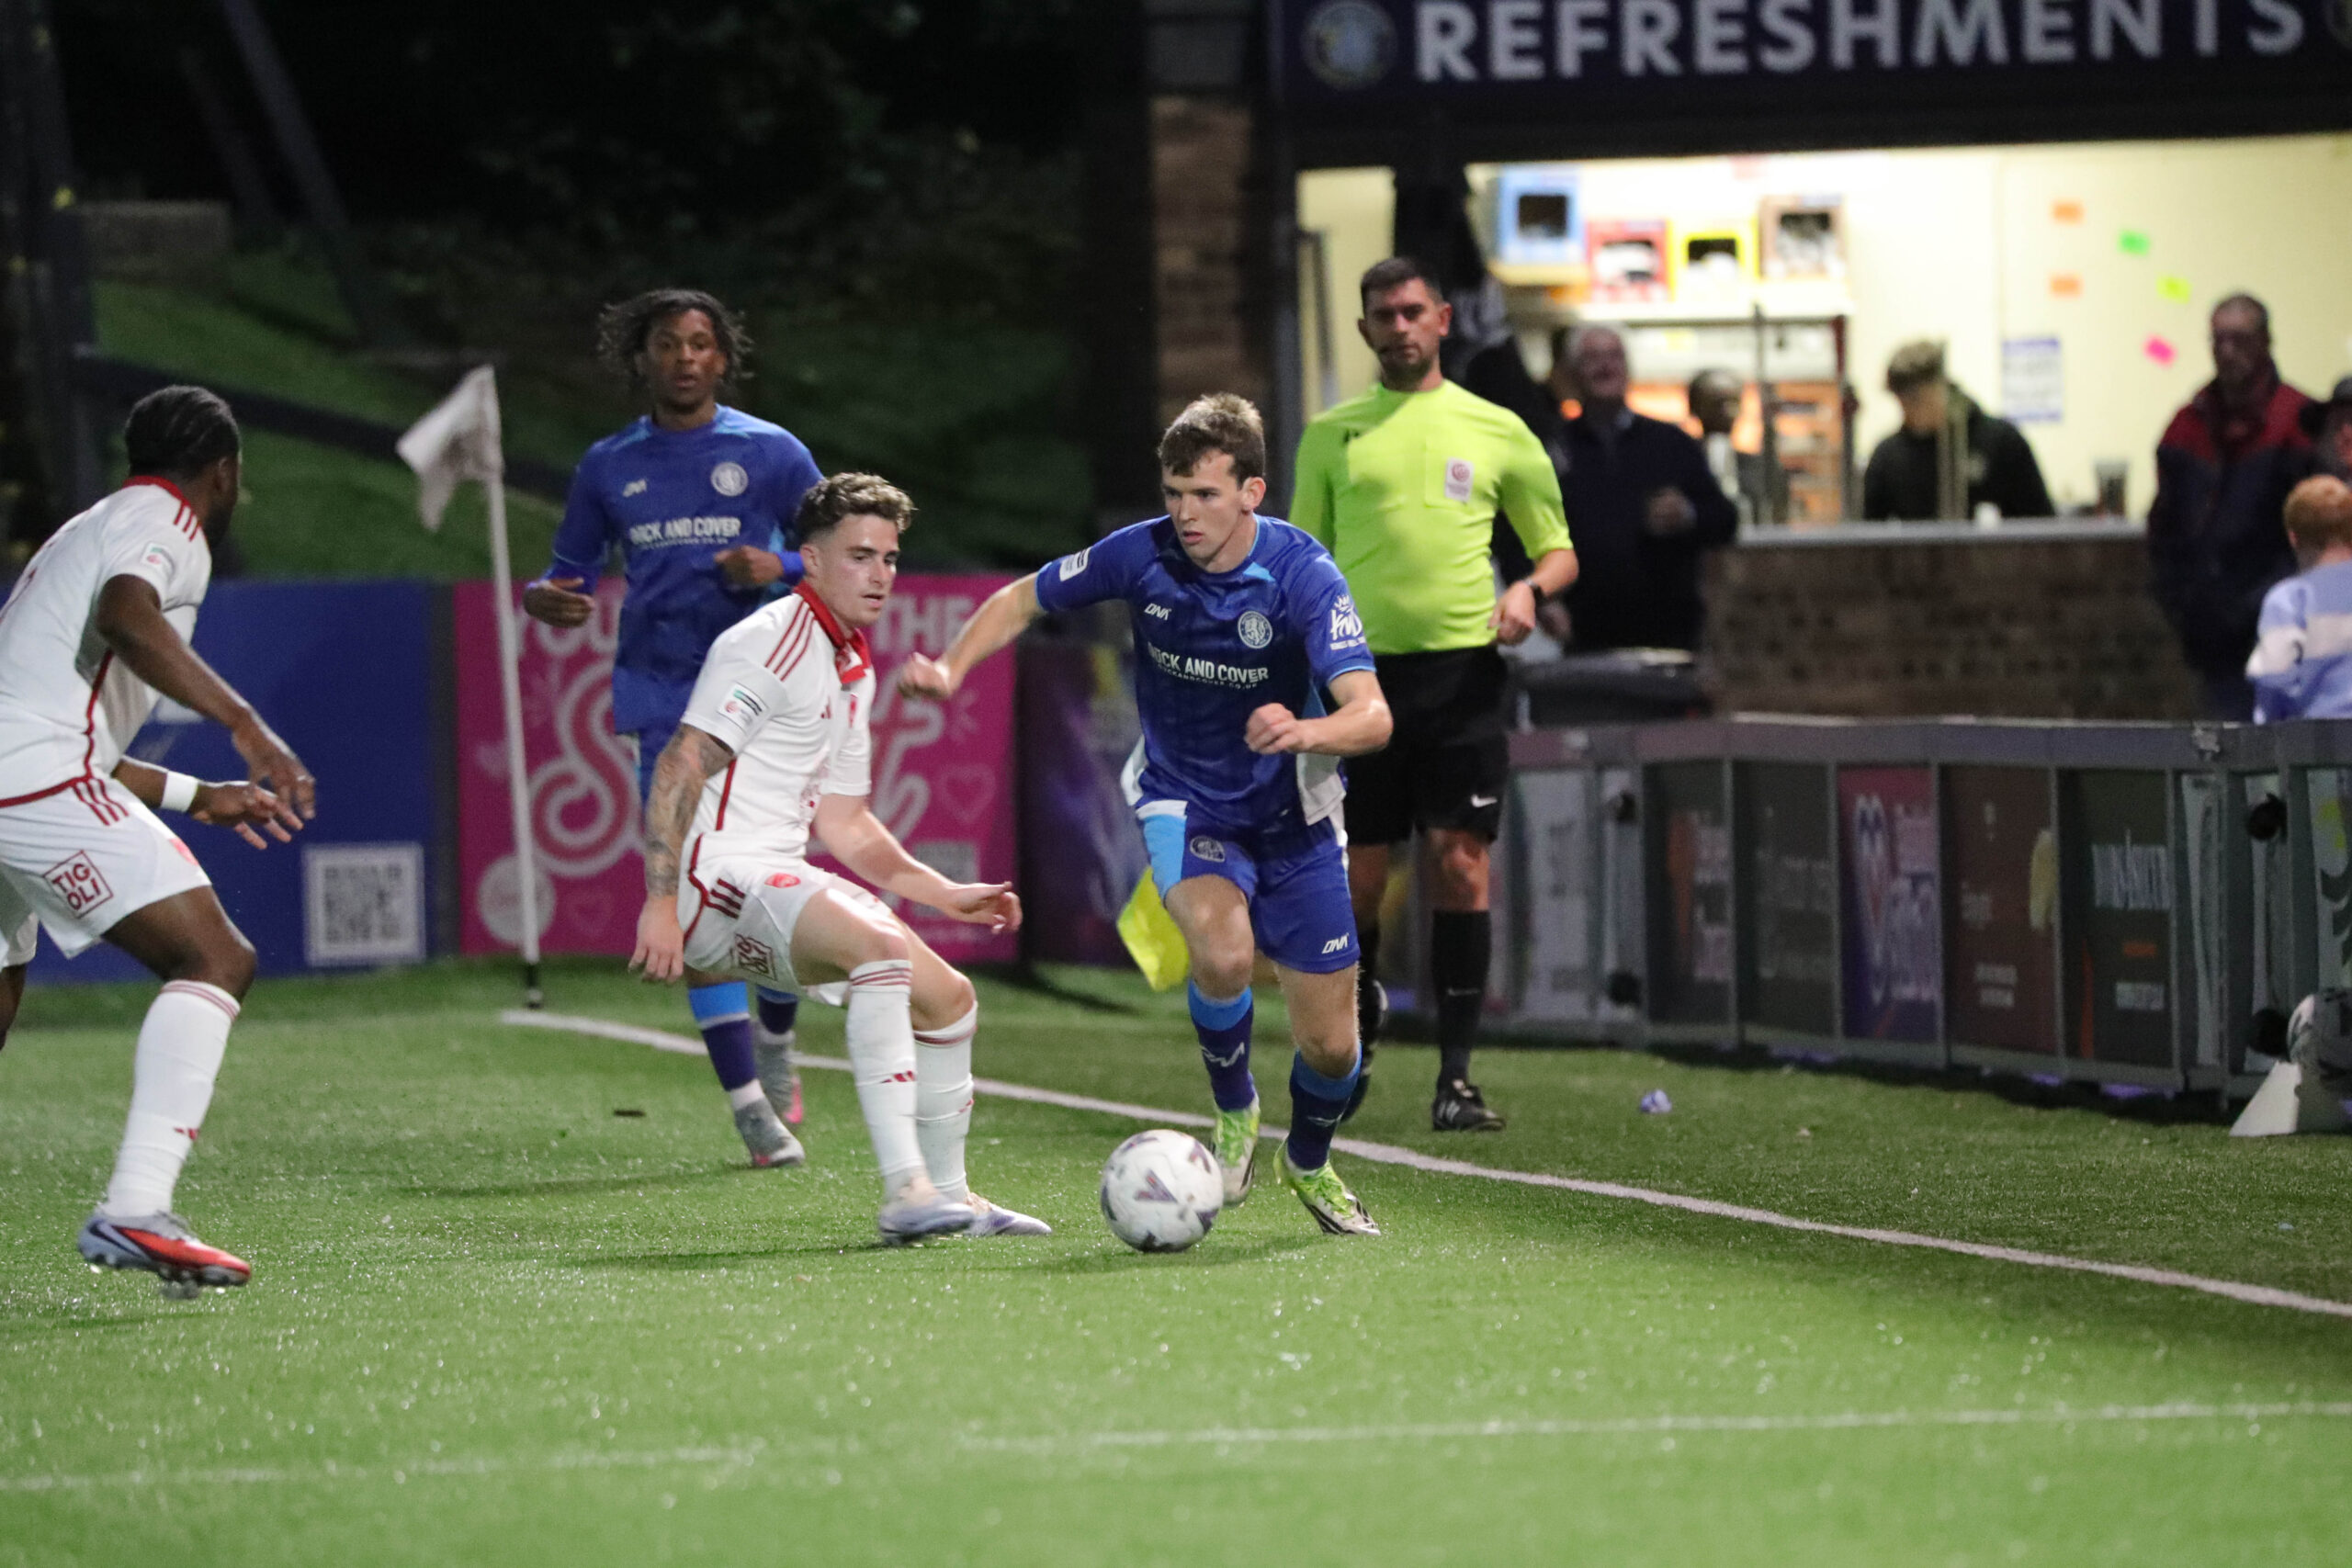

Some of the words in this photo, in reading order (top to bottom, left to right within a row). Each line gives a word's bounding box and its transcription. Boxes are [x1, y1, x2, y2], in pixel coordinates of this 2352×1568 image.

[1415, 0, 2304, 82] REFRESHMENTS
[1184, 657, 1216, 680] AND
[1217, 664, 1270, 684] COVER
[51, 863, 91, 894] TIG
[66, 877, 101, 911] OLI
